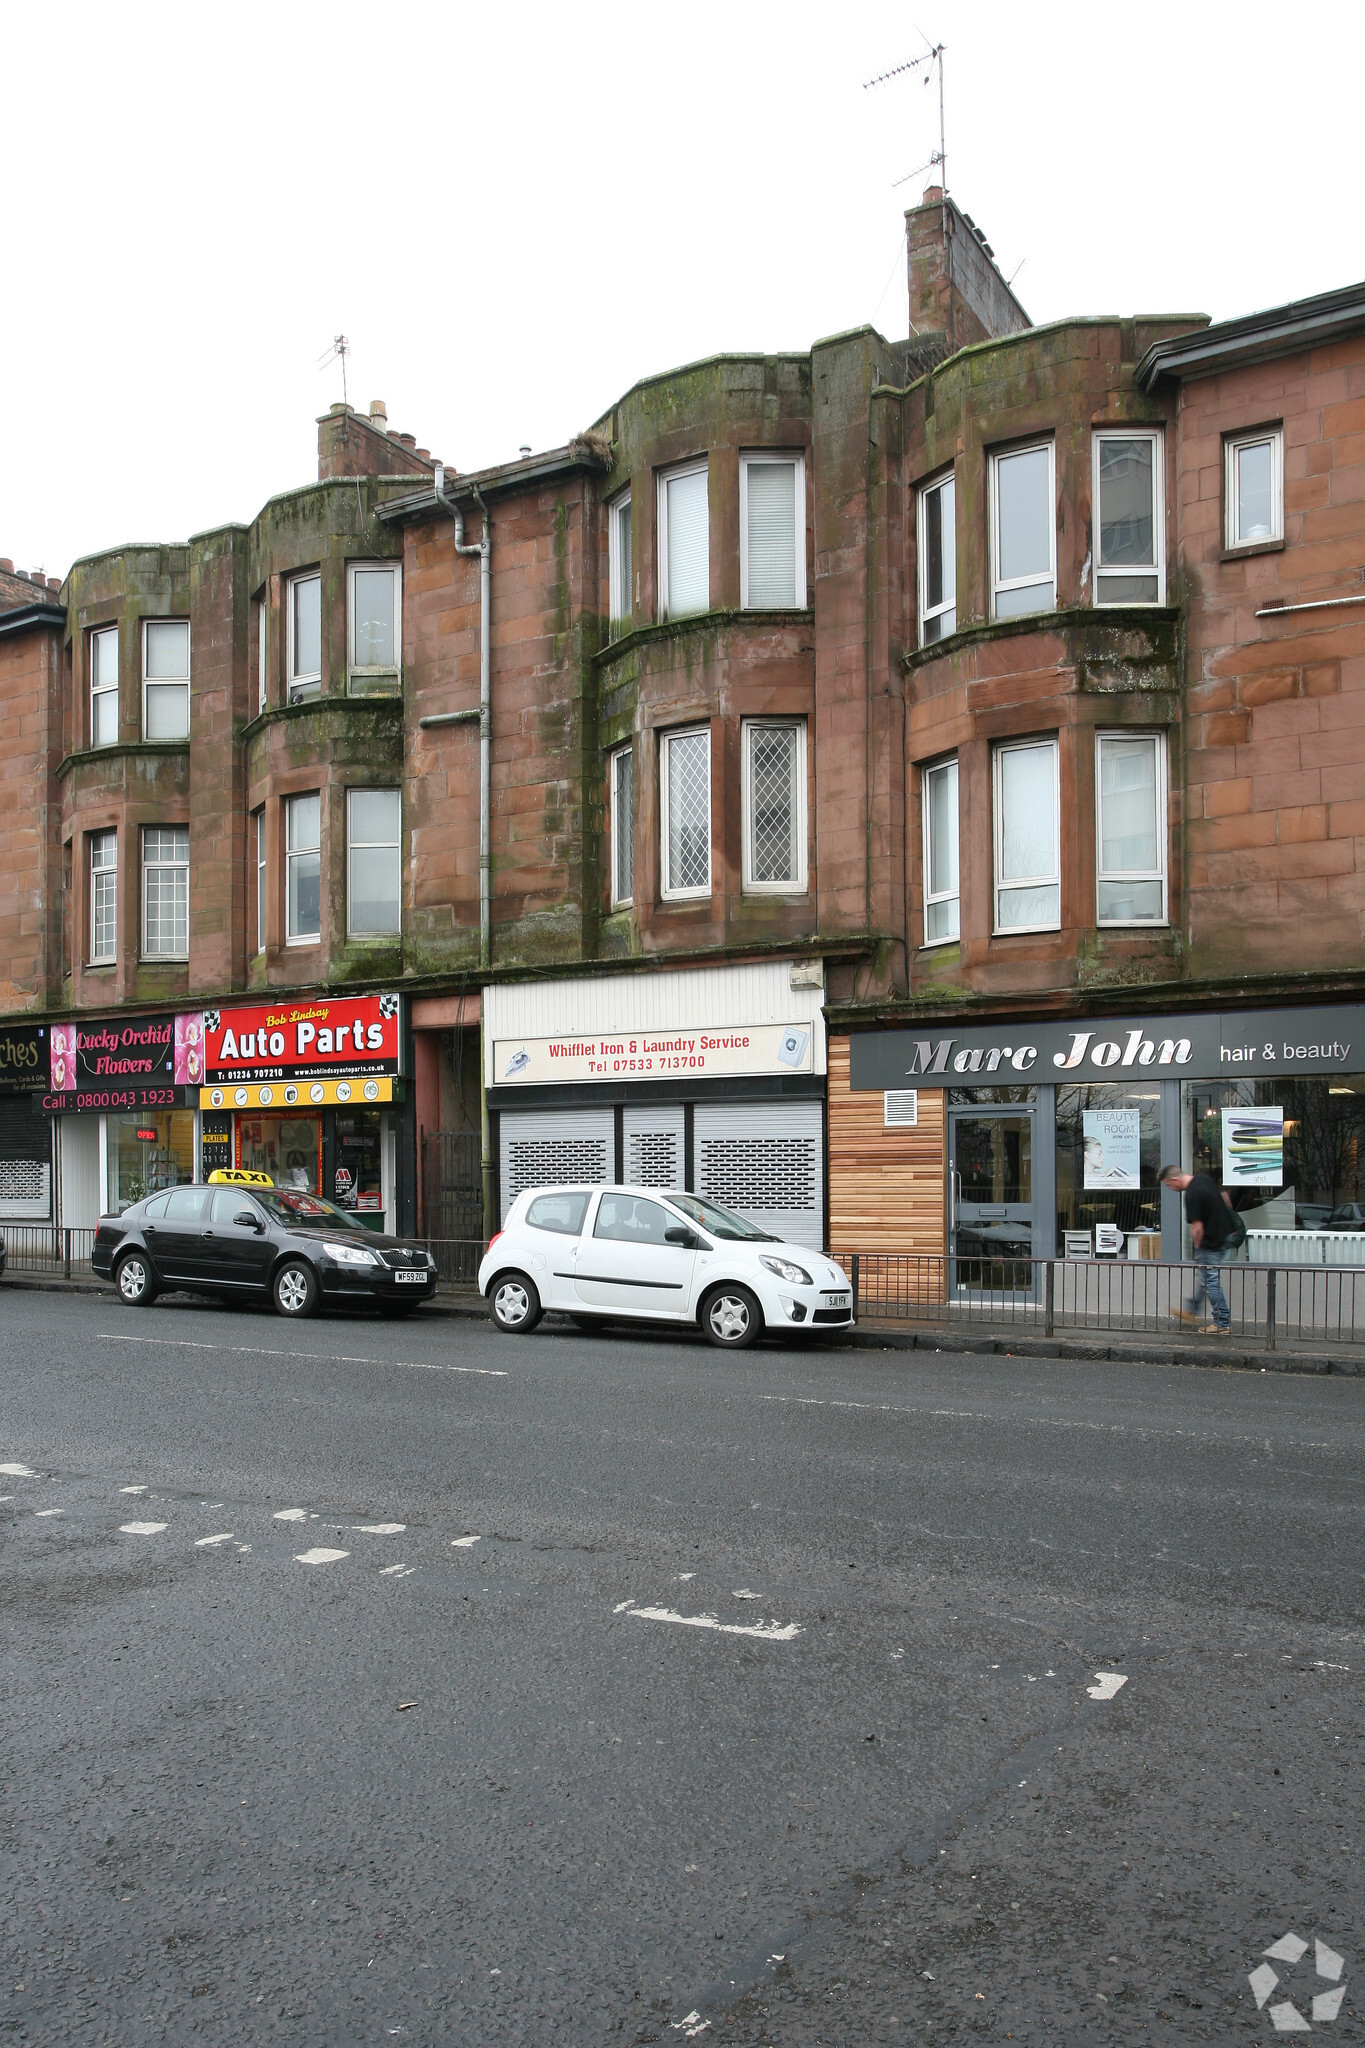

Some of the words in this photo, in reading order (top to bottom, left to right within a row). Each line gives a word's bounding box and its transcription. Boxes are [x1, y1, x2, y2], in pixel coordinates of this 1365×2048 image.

[265, 1014, 287, 1027] Bob
[289, 1007, 330, 1023] Lindsay
[77, 1029, 119, 1051] Lucky
[122, 1024, 173, 1046] Orchid
[219, 1027, 286, 1060] Auto
[297, 1018, 384, 1055] Parts
[549, 1042, 596, 1057] Whifflet
[600, 1040, 625, 1055] Iron
[629, 1040, 638, 1053] &
[643, 1037, 696, 1054] Laundry
[700, 1034, 750, 1050] Service
[905, 1039, 1038, 1075] Marc
[1053, 1030, 1194, 1069] John
[1220, 1044, 1257, 1062] hair
[1262, 1042, 1277, 1061] &
[1283, 1040, 1351, 1062] beauty
[96, 1056, 153, 1075] Flowers
[227, 1070, 251, 1080] 01236
[254, 1068, 283, 1078] 707210
[294, 1064, 385, 1076] www.boblindsayautoparts.co.uk
[589, 1060, 607, 1072] Tel
[613, 1058, 653, 1072] 07533
[660, 1055, 705, 1069] 713700
[42, 1095, 66, 1109] Call
[77, 1093, 109, 1108] 0800
[111, 1092, 136, 1106] 043
[141, 1089, 175, 1105] 1923
[1096, 1112, 1134, 1121] BEAUTY
[137, 1129, 155, 1140] OPEN
[1104, 1125, 1134, 1133] ROOM
[221, 1171, 268, 1183] TAXI
